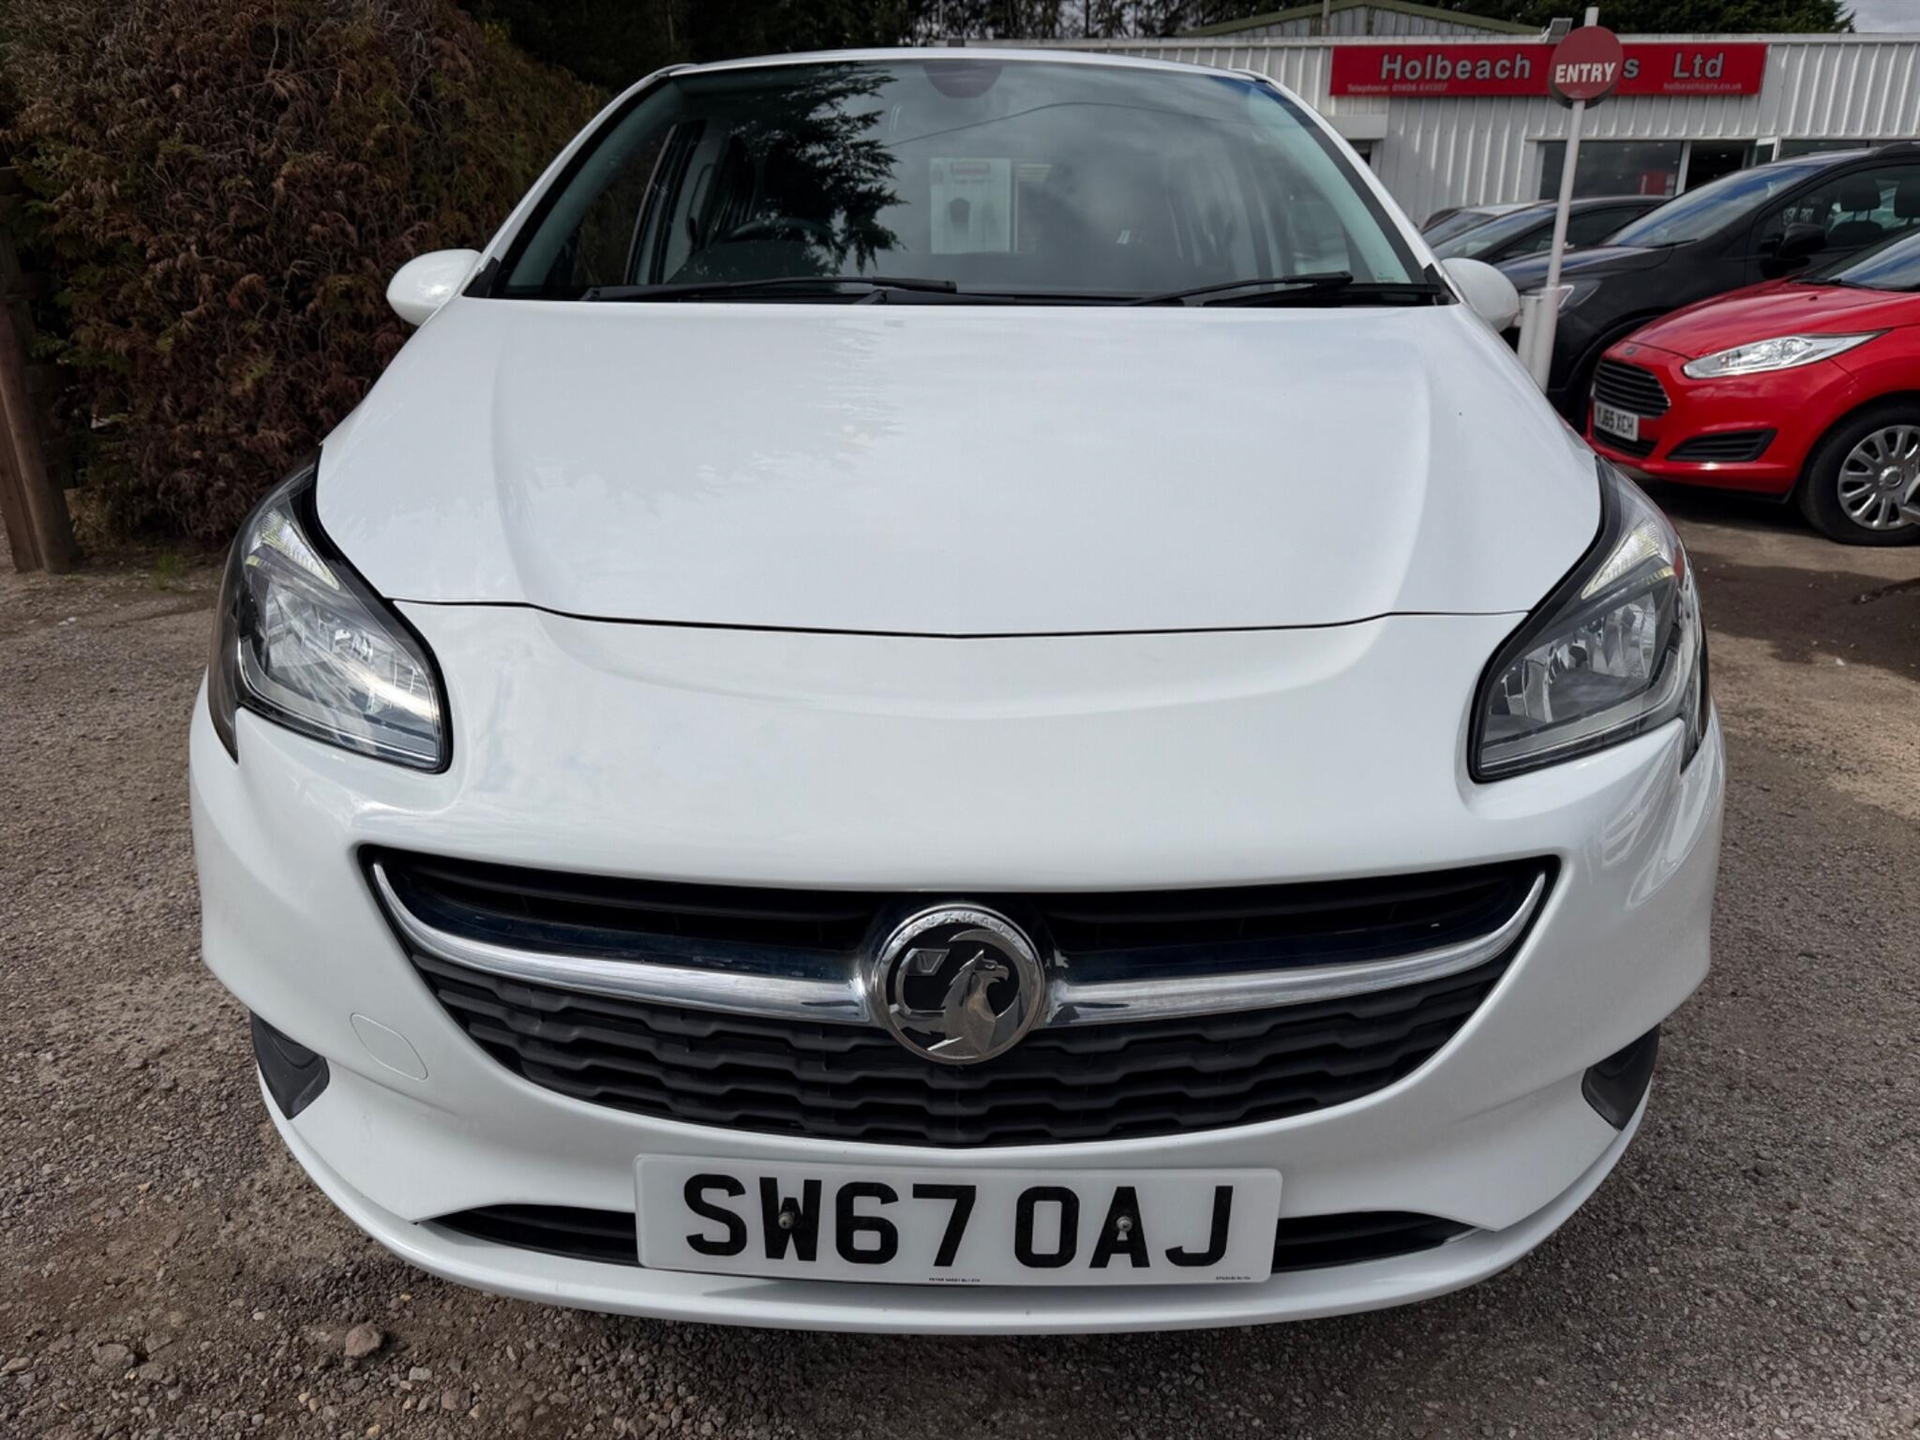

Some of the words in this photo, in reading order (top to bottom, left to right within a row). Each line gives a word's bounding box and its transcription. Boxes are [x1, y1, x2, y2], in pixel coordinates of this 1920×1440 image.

[1381, 53, 1531, 80] Holbeach
[1674, 52, 1724, 78] Ltd
[1555, 62, 1616, 83] ENTRY
[682, 1172, 977, 1267] SW67
[1014, 1185, 1234, 1269] OAJ
